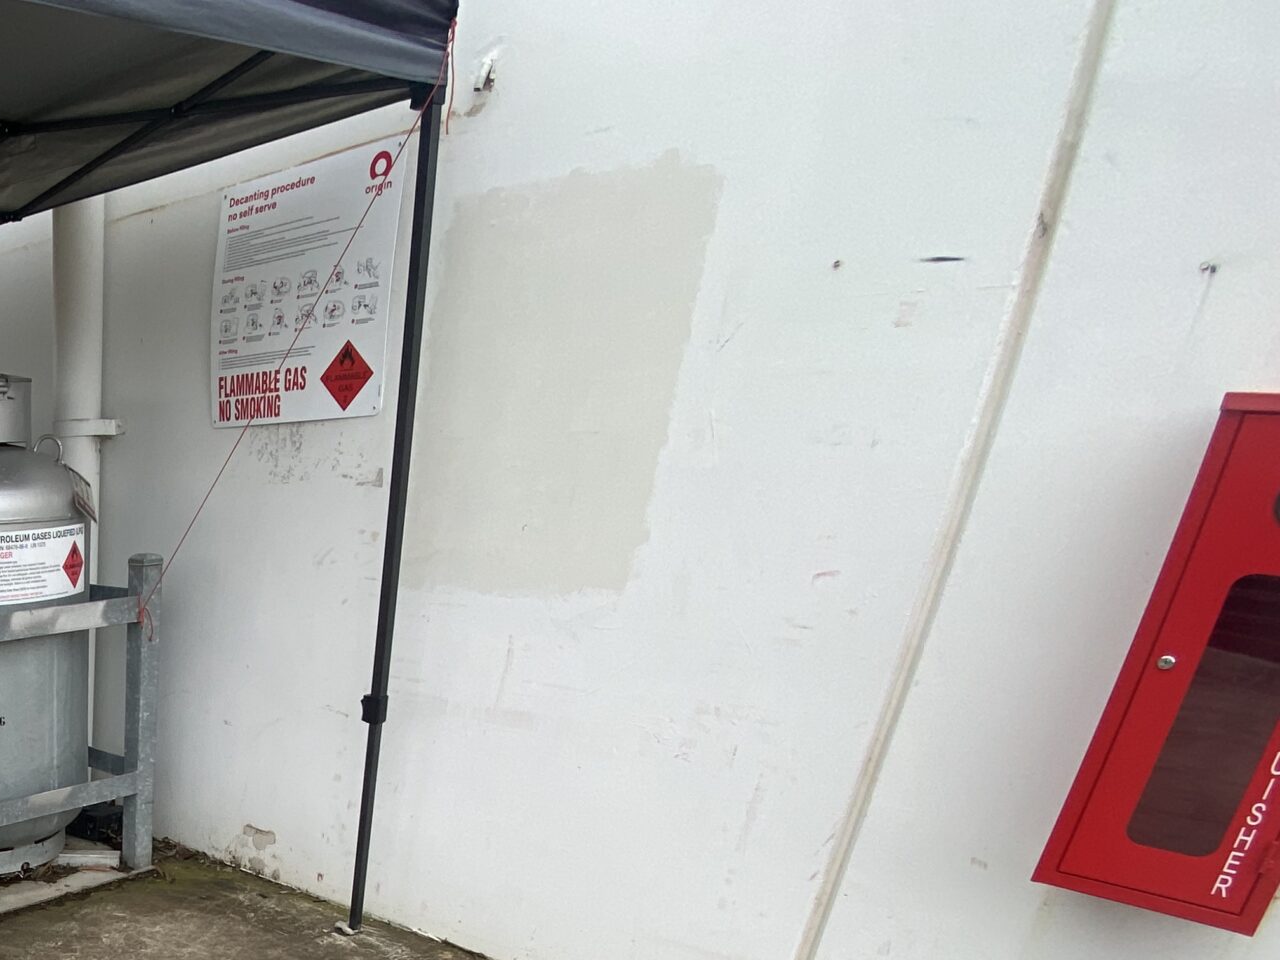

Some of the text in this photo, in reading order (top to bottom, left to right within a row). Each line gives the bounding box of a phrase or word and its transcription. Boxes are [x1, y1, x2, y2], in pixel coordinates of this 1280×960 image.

[229, 175, 315, 208] Decanting procedure
[365, 180, 392, 196] origin
[228, 201, 277, 222] no self serve
[218, 366, 308, 398] FLAMMABLE GAS
[338, 384, 353, 392] GAS
[218, 394, 281, 423] NO SMOKING
[31, 532, 51, 541] GASES
